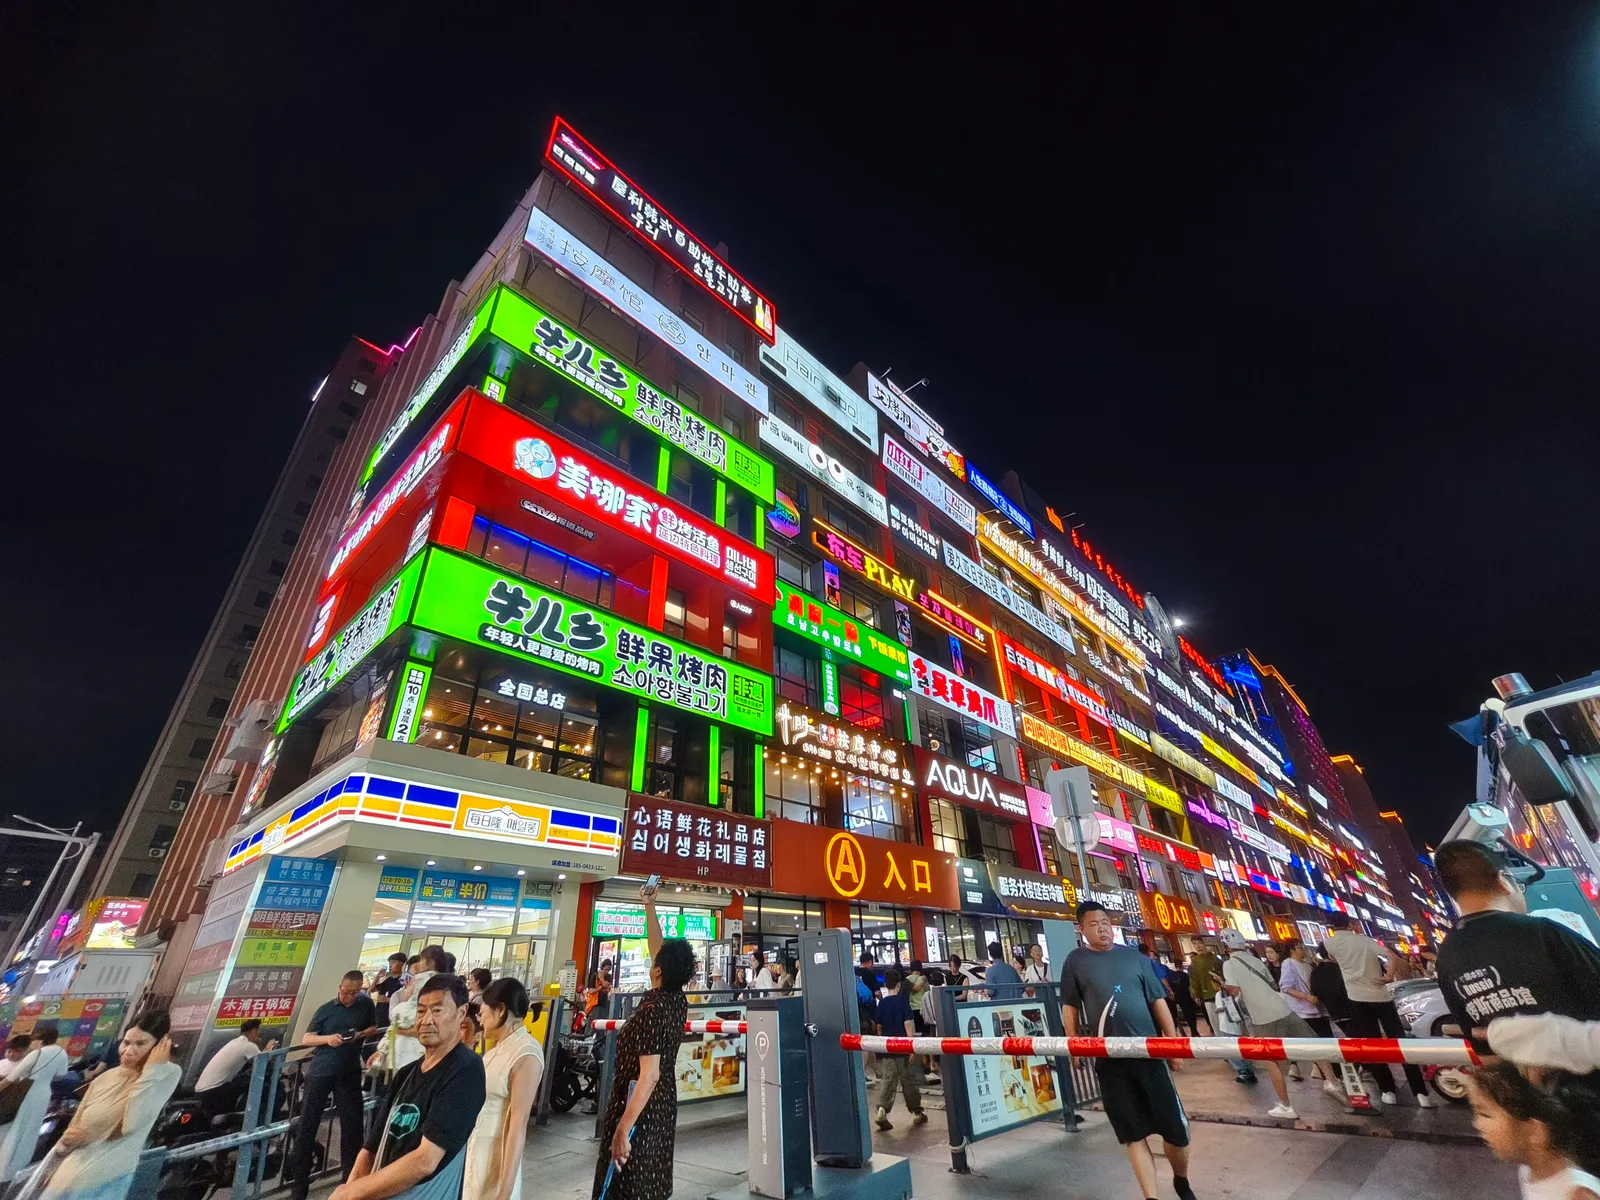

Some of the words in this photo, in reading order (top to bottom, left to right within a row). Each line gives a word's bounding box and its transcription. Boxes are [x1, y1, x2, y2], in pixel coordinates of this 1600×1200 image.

[561, 239, 645, 314] 按摩馆
[533, 317, 629, 391] 牛儿乡
[635, 382, 727, 455] 鲜果烤肉
[695, 342, 758, 400] 안마관
[787, 350, 820, 385] Hair
[557, 457, 654, 534] 美娜家
[658, 508, 720, 554] 鲜烤活鱼
[656, 526, 720, 568] 延边特色料理
[864, 555, 915, 600] PLAY
[484, 579, 607, 652] 牛儿乡
[615, 627, 728, 694] 鲜果烤肉
[484, 626, 601, 676] 年轻人更喜爱的烤肉
[497, 677, 568, 710] 全国总店
[612, 662, 727, 718] 소아향불고기
[735, 676, 763, 701] 非遗
[926, 759, 999, 807] AQUA
[470, 812, 502, 829] 每日隆
[633, 806, 766, 847] 心语鲜花礼品店
[843, 804, 889, 831] AQUA
[631, 828, 766, 869] 심어생화례물점
[421, 886, 454, 899] 第二件
[458, 881, 488, 901] 半价
[697, 866, 710, 876] HP
[883, 850, 932, 893] 入口
[999, 876, 1065, 904] 服务大楼延吉冷面
[253, 909, 319, 925] 朝鲜族民宿
[1170, 902, 1192, 926] 入口
[223, 997, 293, 1011] 木浦石锅饭
